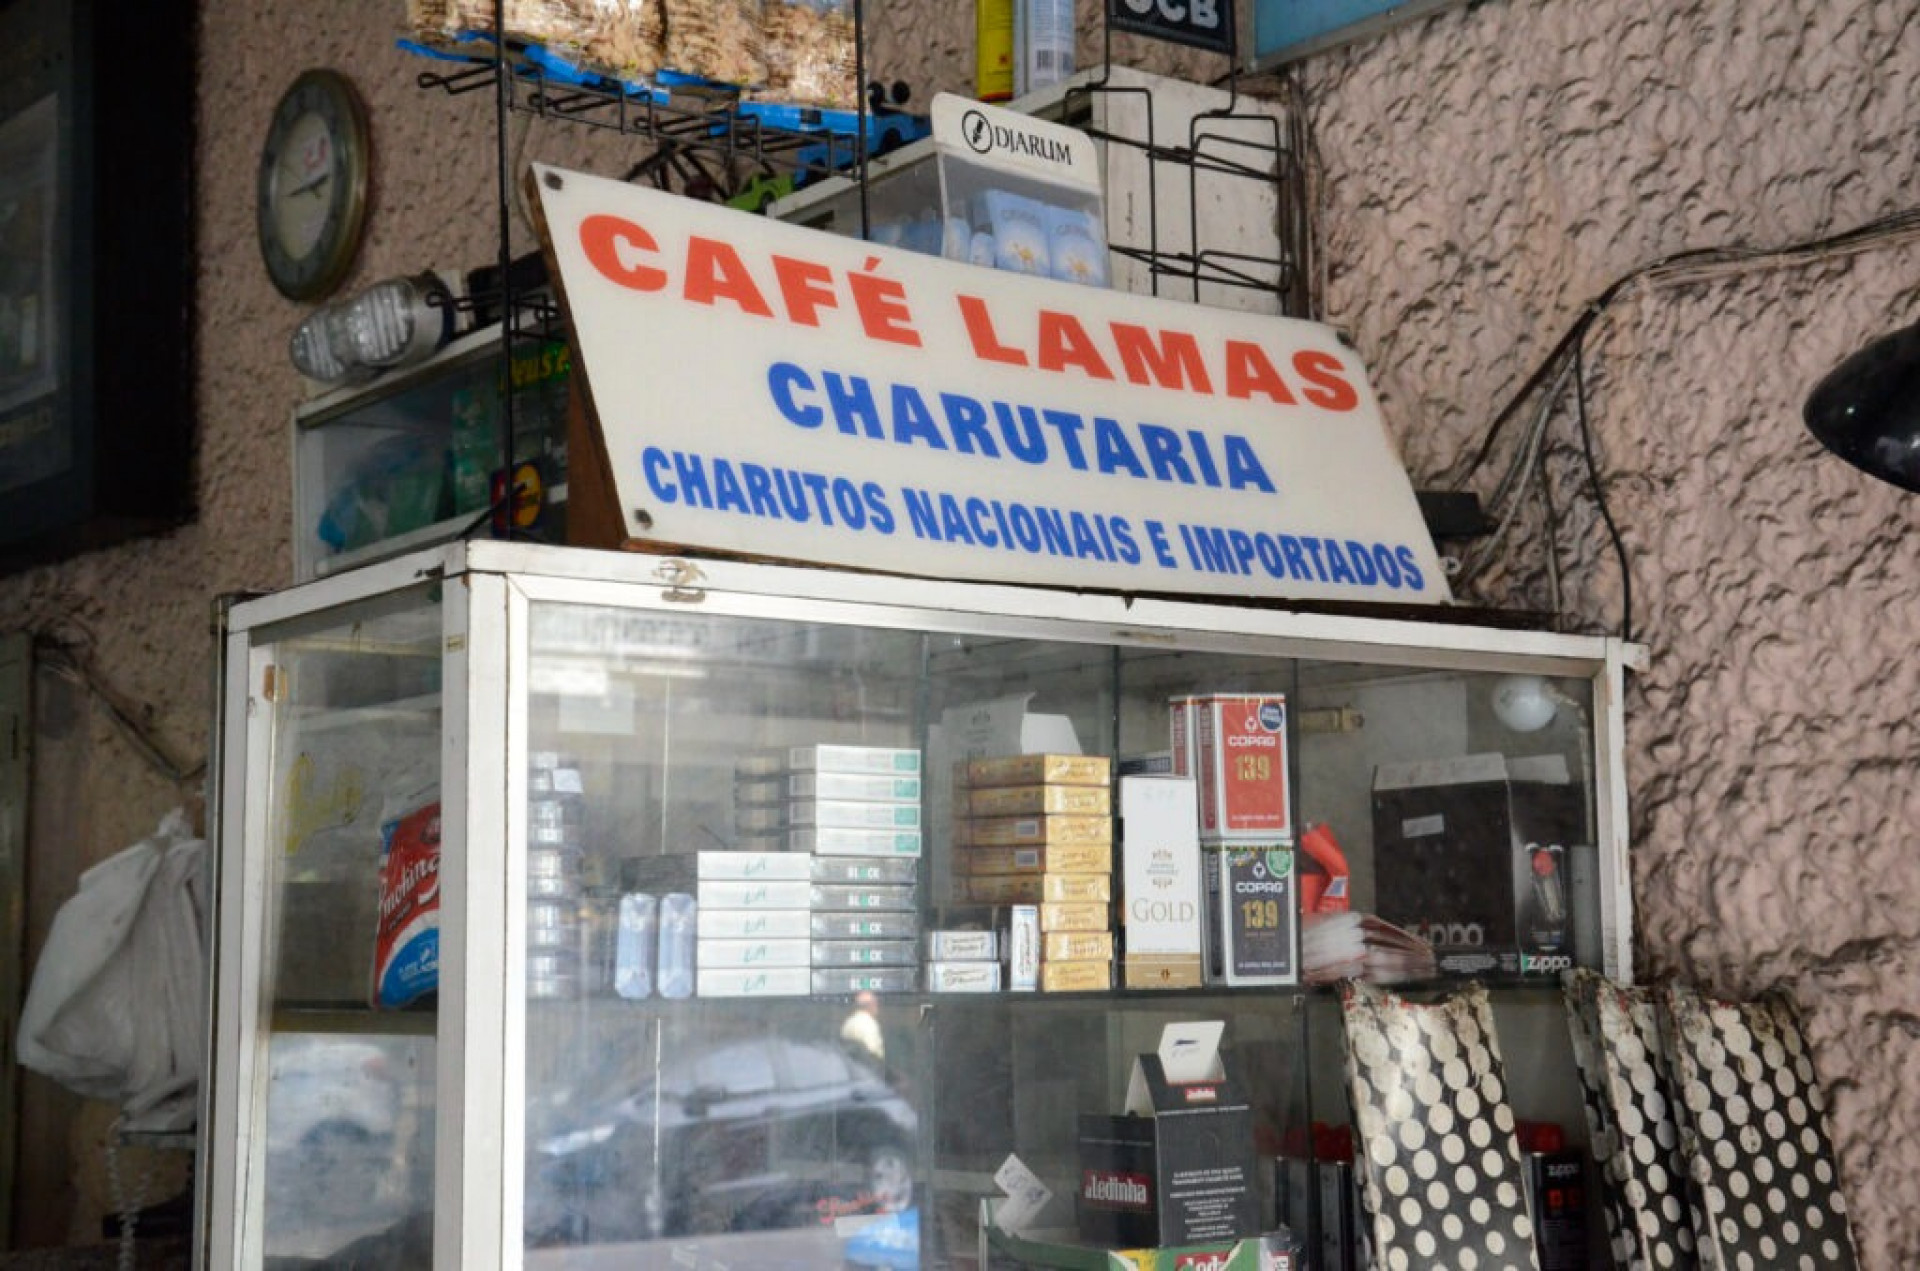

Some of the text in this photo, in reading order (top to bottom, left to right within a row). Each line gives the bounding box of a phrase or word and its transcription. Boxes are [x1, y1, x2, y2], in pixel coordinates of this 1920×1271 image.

[995, 125, 1073, 166] DJARUM
[579, 214, 1359, 412] CAFÉ LAMAS
[768, 362, 1275, 492] CHARUTARIA
[643, 447, 1423, 590] CHARUTOS NACIONAIS E IMPORTADOS
[1227, 735, 1276, 747] COPAG
[1235, 754, 1271, 781] 139
[1235, 880, 1284, 893] COPAG
[1131, 897, 1195, 924] GOLD
[1242, 900, 1278, 929] 139
[1527, 953, 1572, 974] zippo
